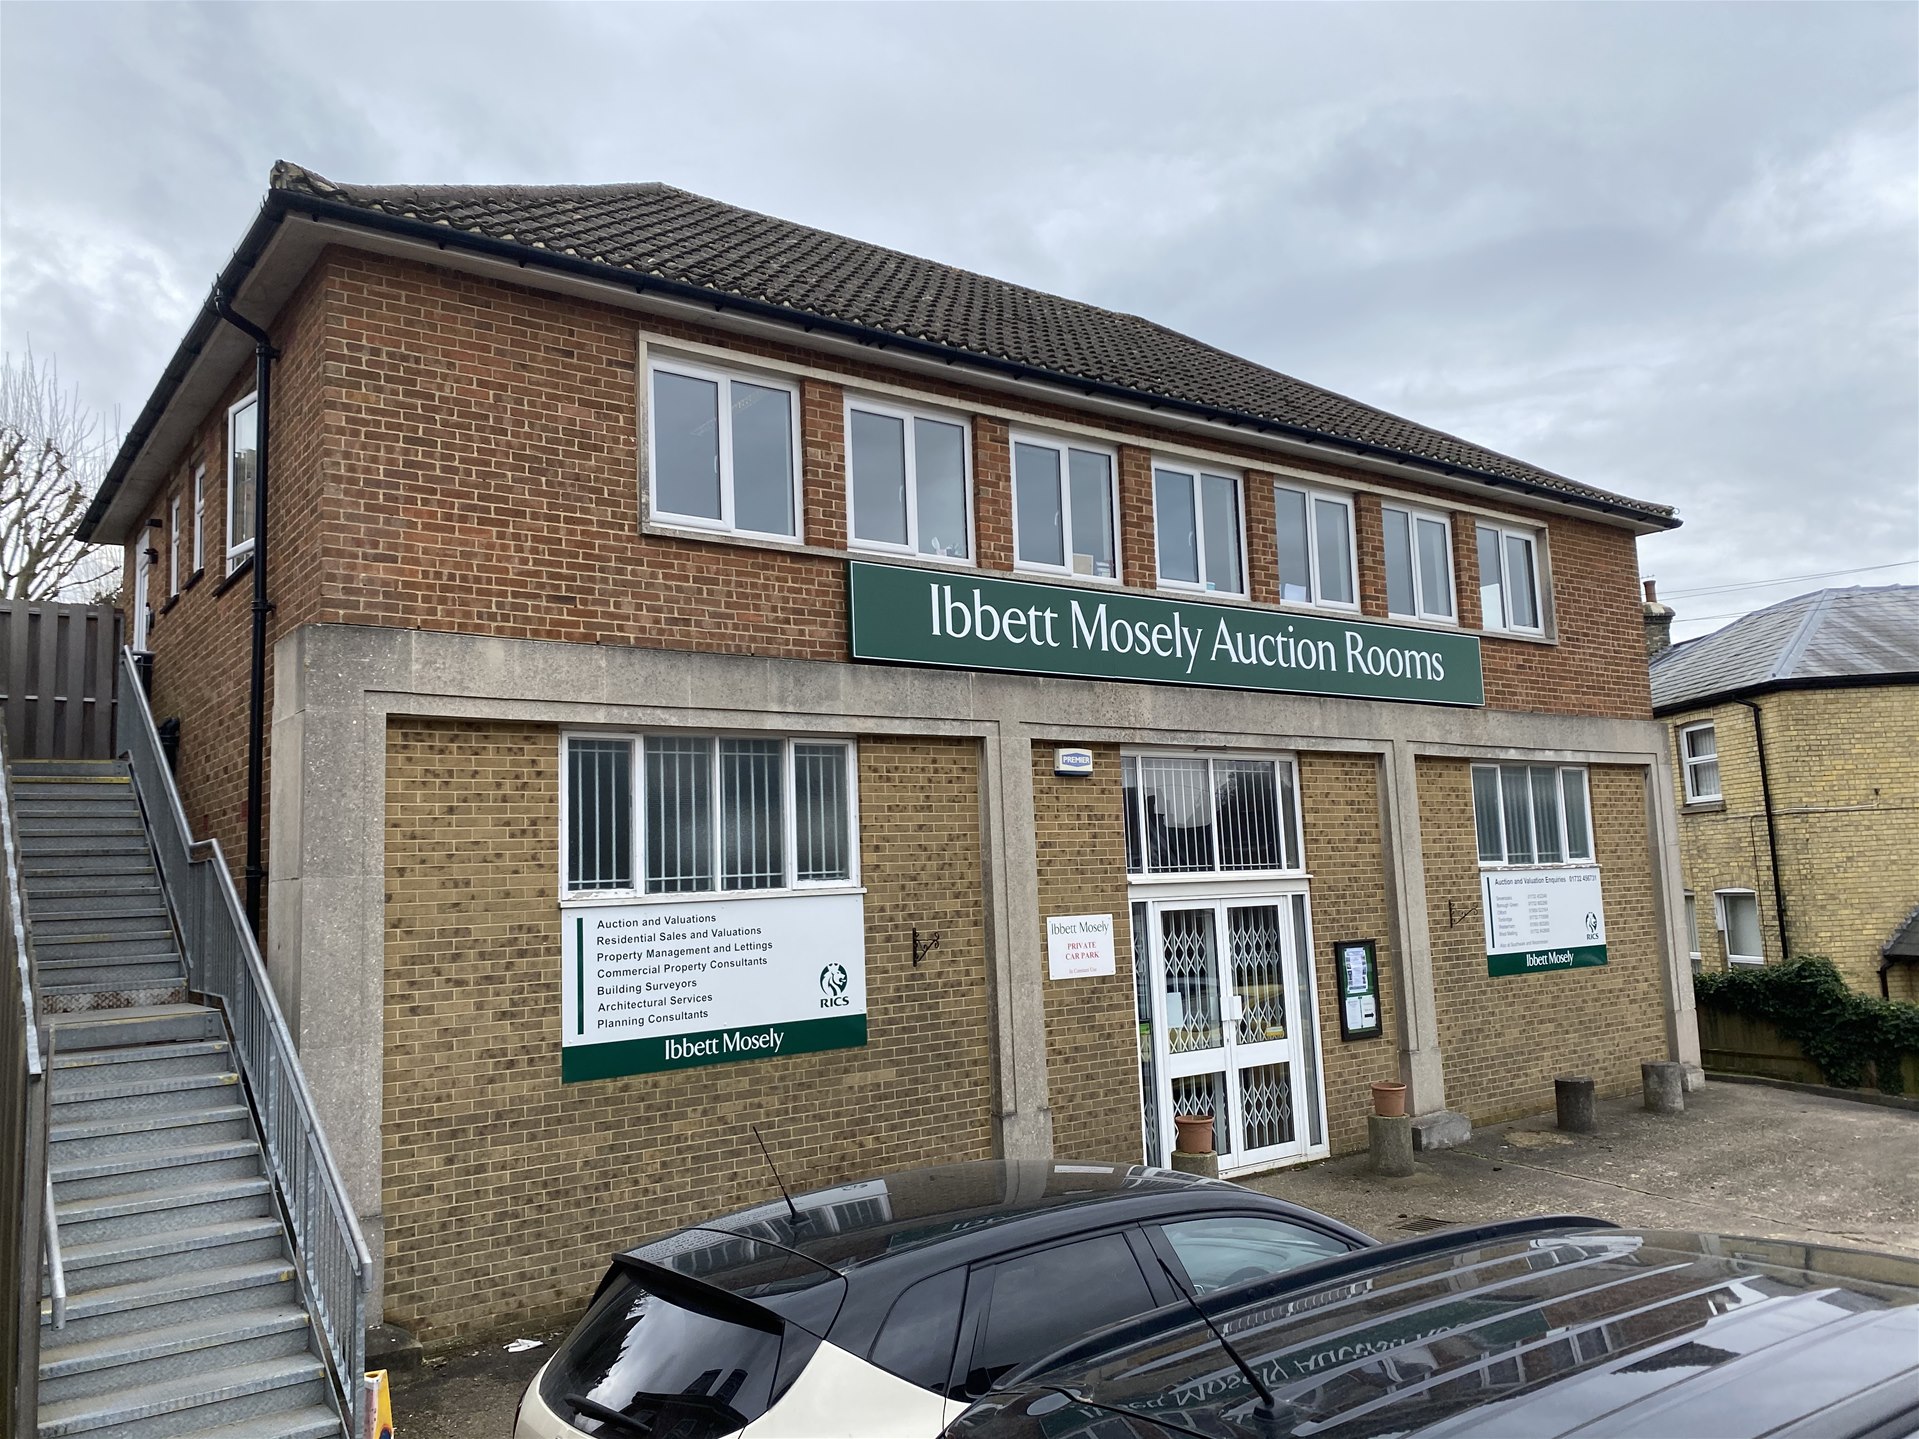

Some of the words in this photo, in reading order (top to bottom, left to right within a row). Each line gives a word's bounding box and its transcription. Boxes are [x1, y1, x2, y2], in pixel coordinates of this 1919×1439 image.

[930, 583, 1060, 647] Ibbett
[1069, 599, 1203, 674] Mosely
[1210, 616, 1338, 671] Auction
[1346, 630, 1446, 681] Rooms
[597, 919, 638, 929] Auction
[642, 917, 661, 926] and
[664, 913, 716, 925] Valuations
[1051, 923, 1077, 935] Ibbett
[1079, 921, 1109, 935] Mosely
[597, 933, 656, 945] Residential
[659, 932, 687, 941] Sales
[690, 929, 708, 939] and
[711, 928, 762, 937] Valuations
[597, 951, 643, 963] Property
[646, 946, 710, 958] Management
[713, 943, 731, 953] and
[734, 942, 773, 952] Lettings
[1067, 941, 1096, 950] PRIVATE
[1081, 951, 1099, 959] PARK
[1526, 954, 1548, 967] Ibbett
[1548, 950, 1574, 966] Mosely
[597, 965, 660, 979] Commercial
[664, 962, 707, 973] Property
[710, 957, 768, 969] Consultants
[597, 984, 642, 996] Building
[645, 980, 697, 991] Surveyors
[598, 997, 666, 1012] Architectural
[670, 994, 713, 1005] Services
[820, 996, 849, 1008] RICS
[597, 1017, 644, 1029] Planning
[648, 1010, 708, 1024] Consultants
[665, 1038, 719, 1060] Ibbett
[723, 1028, 784, 1053] Mosely
